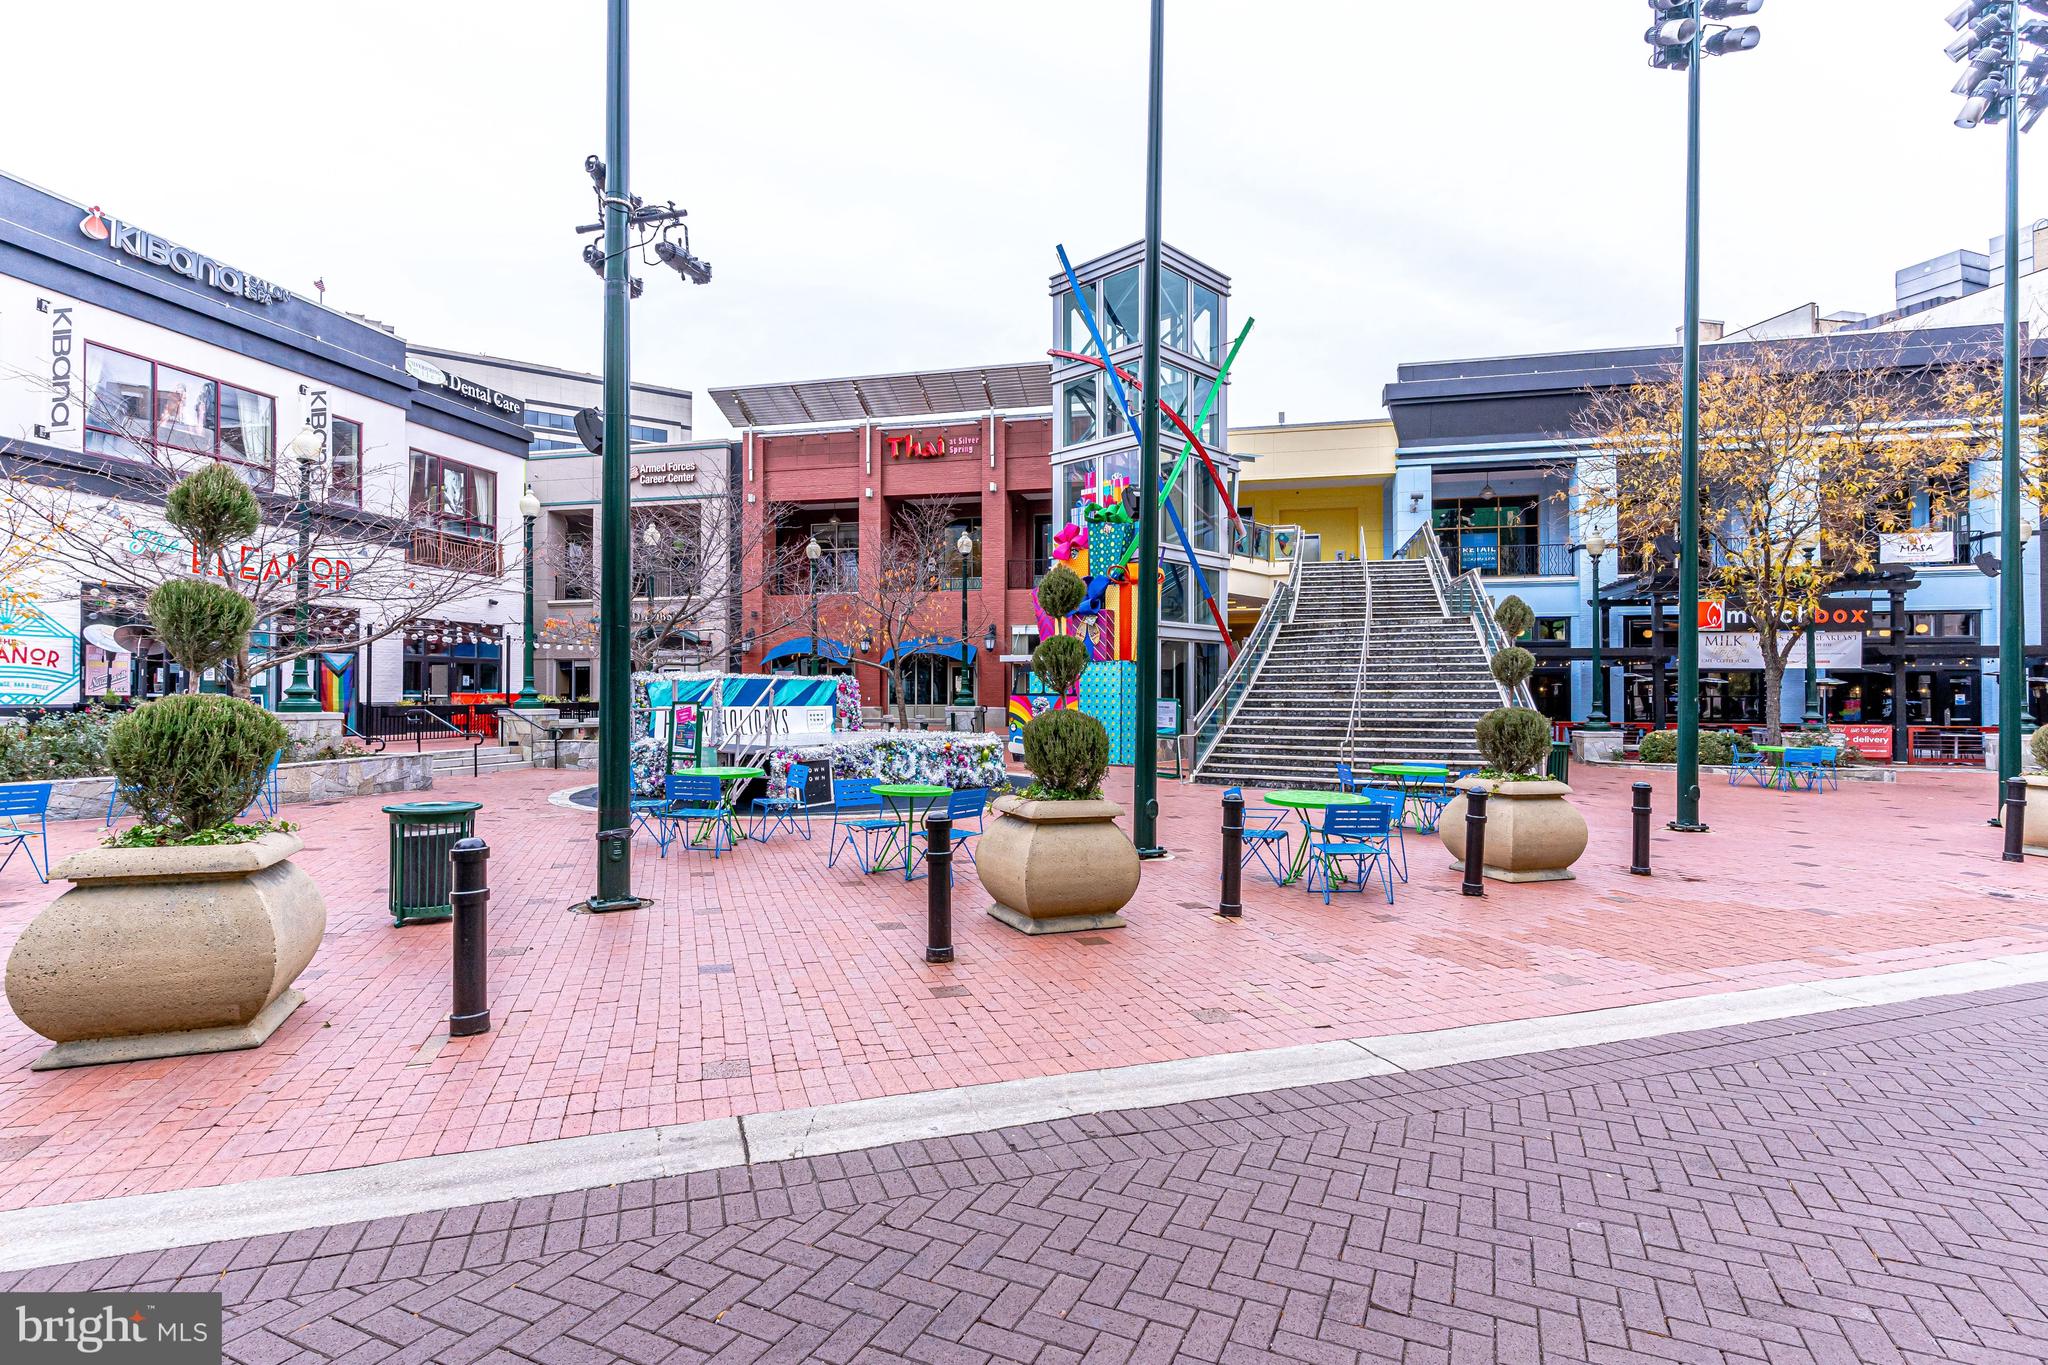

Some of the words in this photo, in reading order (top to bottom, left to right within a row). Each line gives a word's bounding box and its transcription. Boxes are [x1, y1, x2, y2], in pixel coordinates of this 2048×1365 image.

[449, 374, 491, 404] Dental
[494, 392, 520, 413] Care
[885, 433, 945, 458] Thai
[958, 436, 979, 445] Silver
[949, 445, 973, 455] Spring
[640, 462, 667, 473] Armed
[668, 461, 697, 472] Forces
[640, 473, 667, 484] Career
[668, 473, 695, 483] Center
[129, 529, 181, 555] The
[1900, 543, 1934, 552] MASA
[1705, 634, 1743, 646] MILK
[1852, 735, 1889, 745] delivery
[808, 766, 825, 774] OWN
